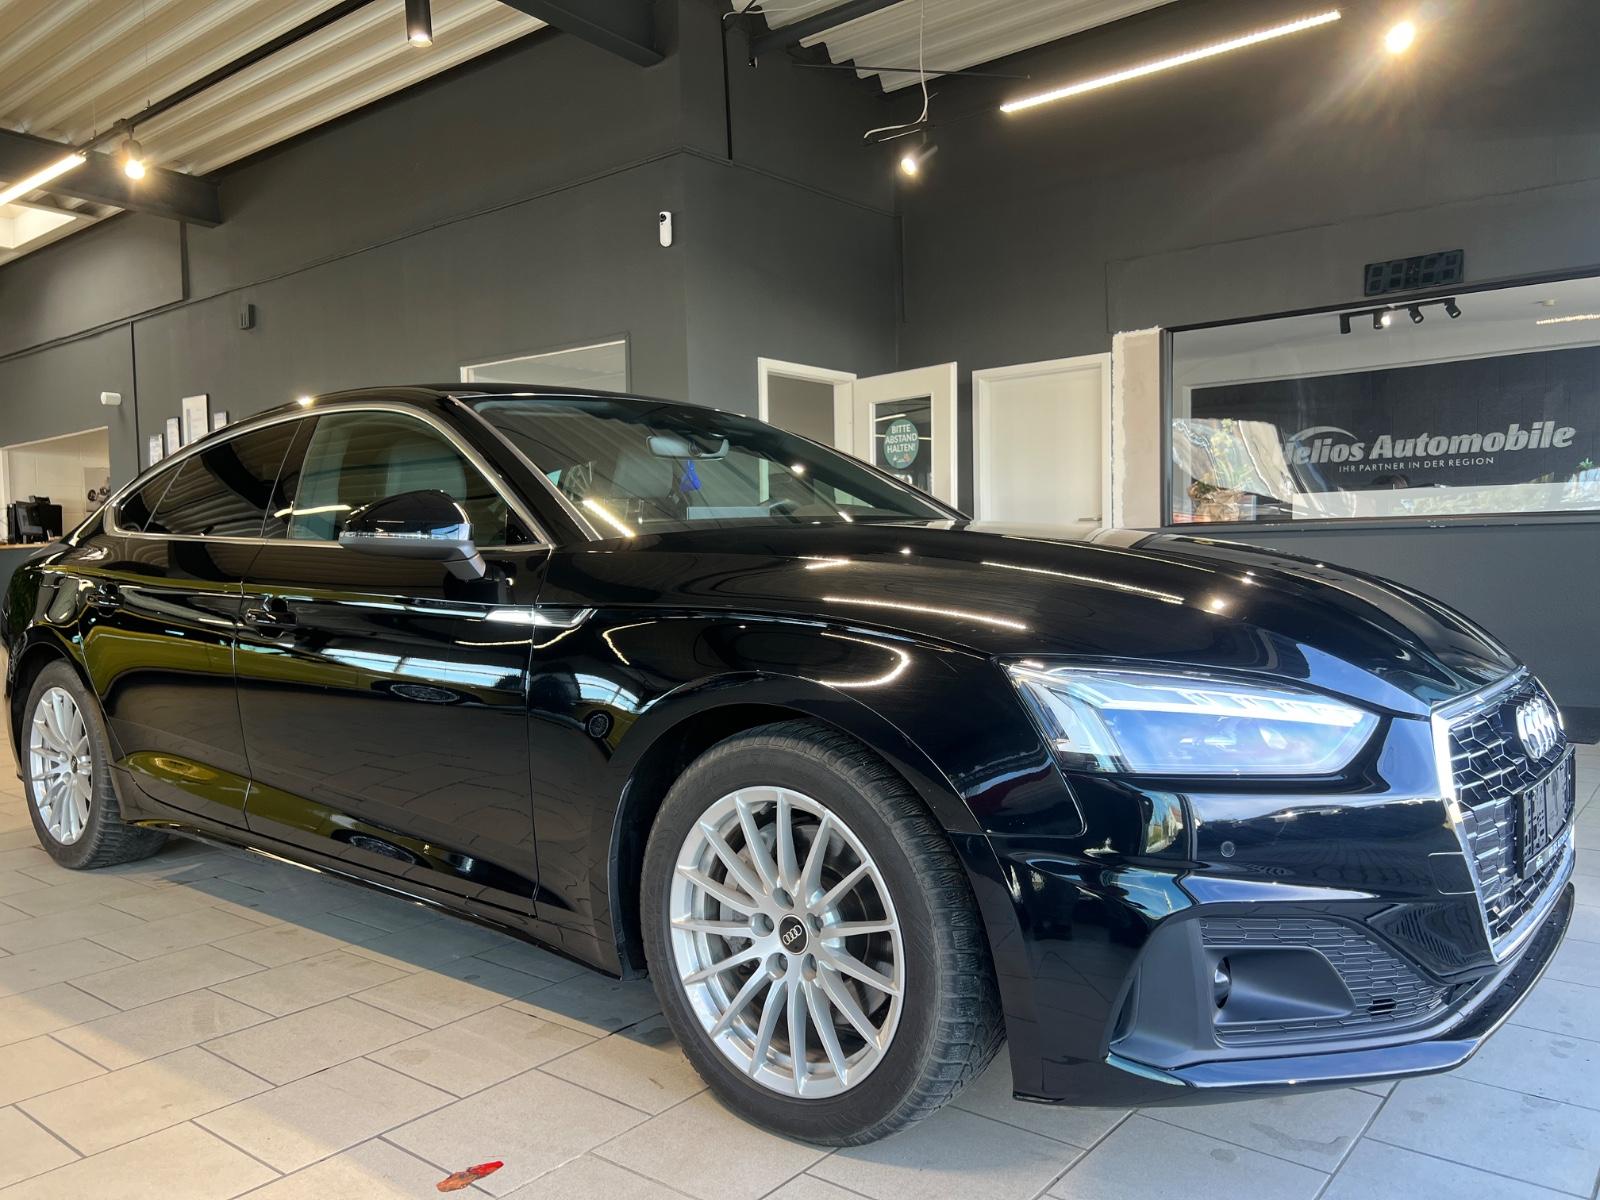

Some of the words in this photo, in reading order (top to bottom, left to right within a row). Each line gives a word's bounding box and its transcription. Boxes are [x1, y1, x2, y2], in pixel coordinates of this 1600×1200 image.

[891, 424, 911, 434] BITTE
[885, 433, 918, 445] ABSTAND
[1368, 421, 1577, 460] Automobile
[886, 443, 916, 454] HALTEN!
[1338, 465, 1356, 473] IHR
[1359, 462, 1405, 472] PARTNER
[1408, 461, 1420, 469] IN
[1424, 460, 1445, 469] DER
[1448, 457, 1494, 467] REGION
